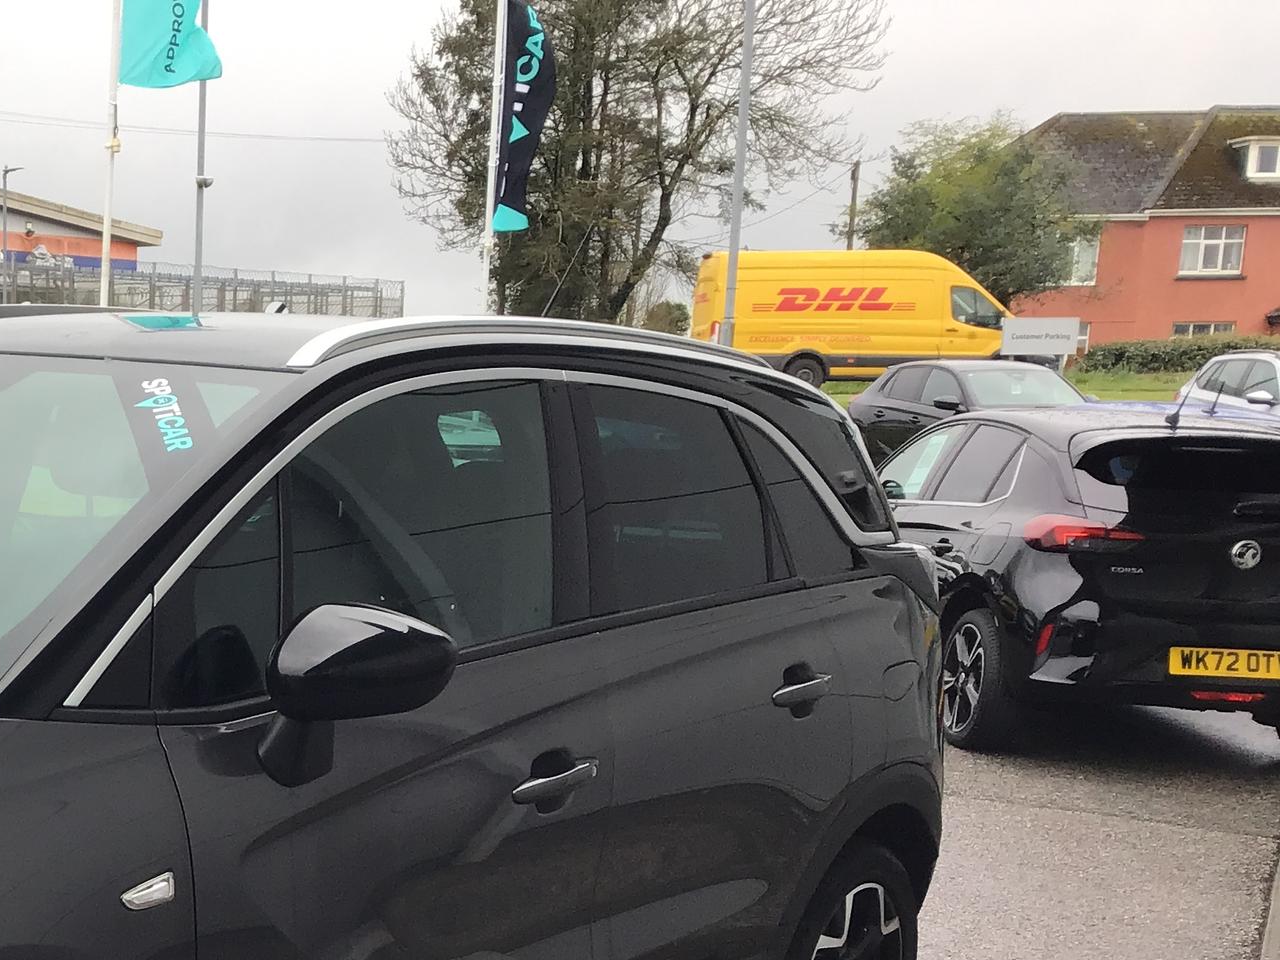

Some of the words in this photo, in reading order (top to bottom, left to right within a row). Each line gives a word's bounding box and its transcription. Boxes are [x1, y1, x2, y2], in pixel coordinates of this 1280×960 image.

[164, 0, 185, 73] APPRO
[774, 287, 894, 312] DHL
[1044, 333, 1071, 341] Parking
[1111, 566, 1144, 574] CORSA
[1180, 649, 1240, 673] WK72
[1246, 652, 1280, 674] OT
